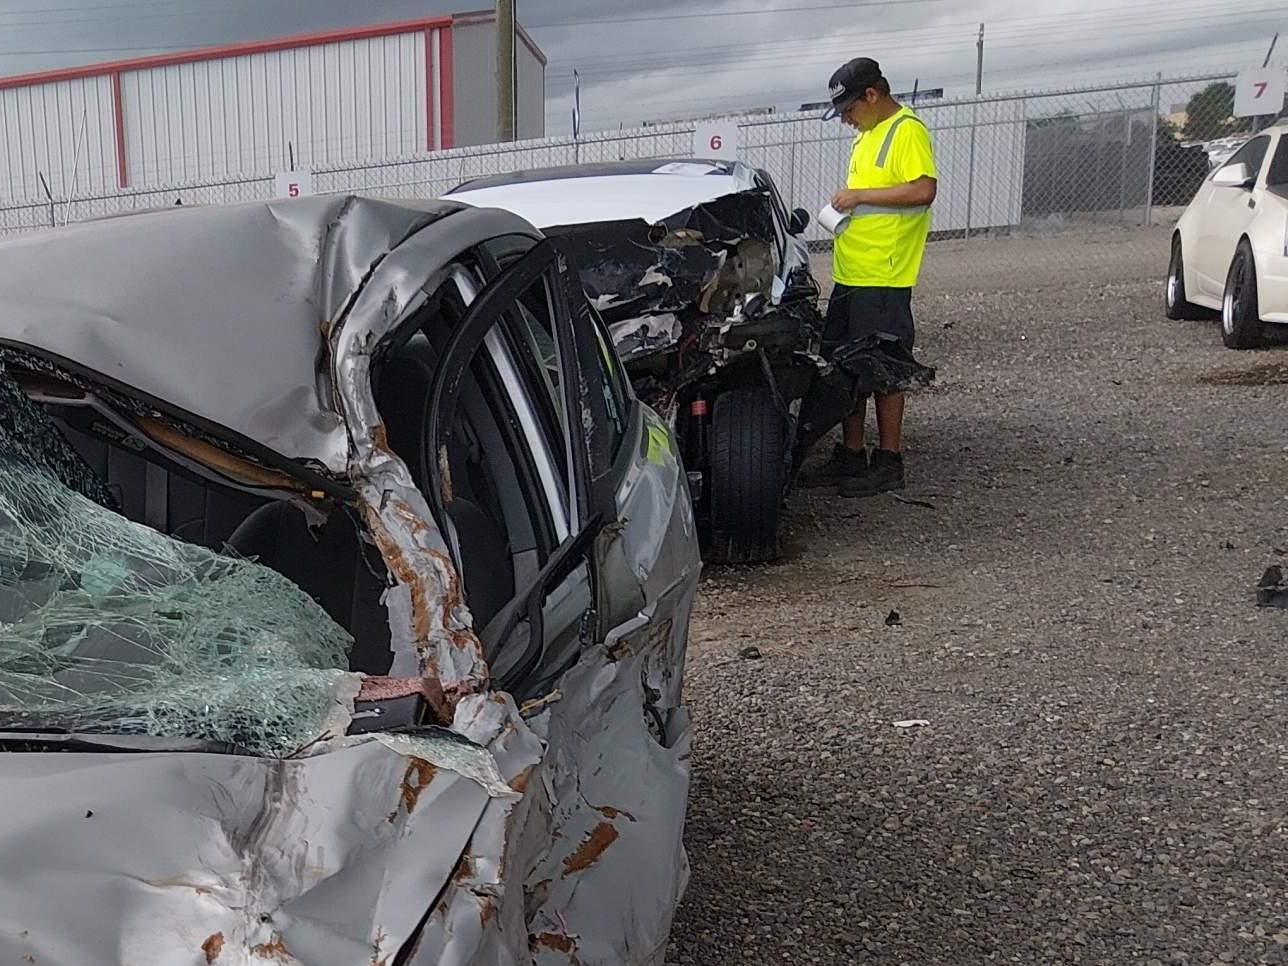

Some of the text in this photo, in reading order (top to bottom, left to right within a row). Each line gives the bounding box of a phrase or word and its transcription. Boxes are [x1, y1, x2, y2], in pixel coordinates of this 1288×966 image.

[1253, 82, 1267, 98] 7
[710, 135, 722, 150] 6
[288, 183, 299, 197] 5
